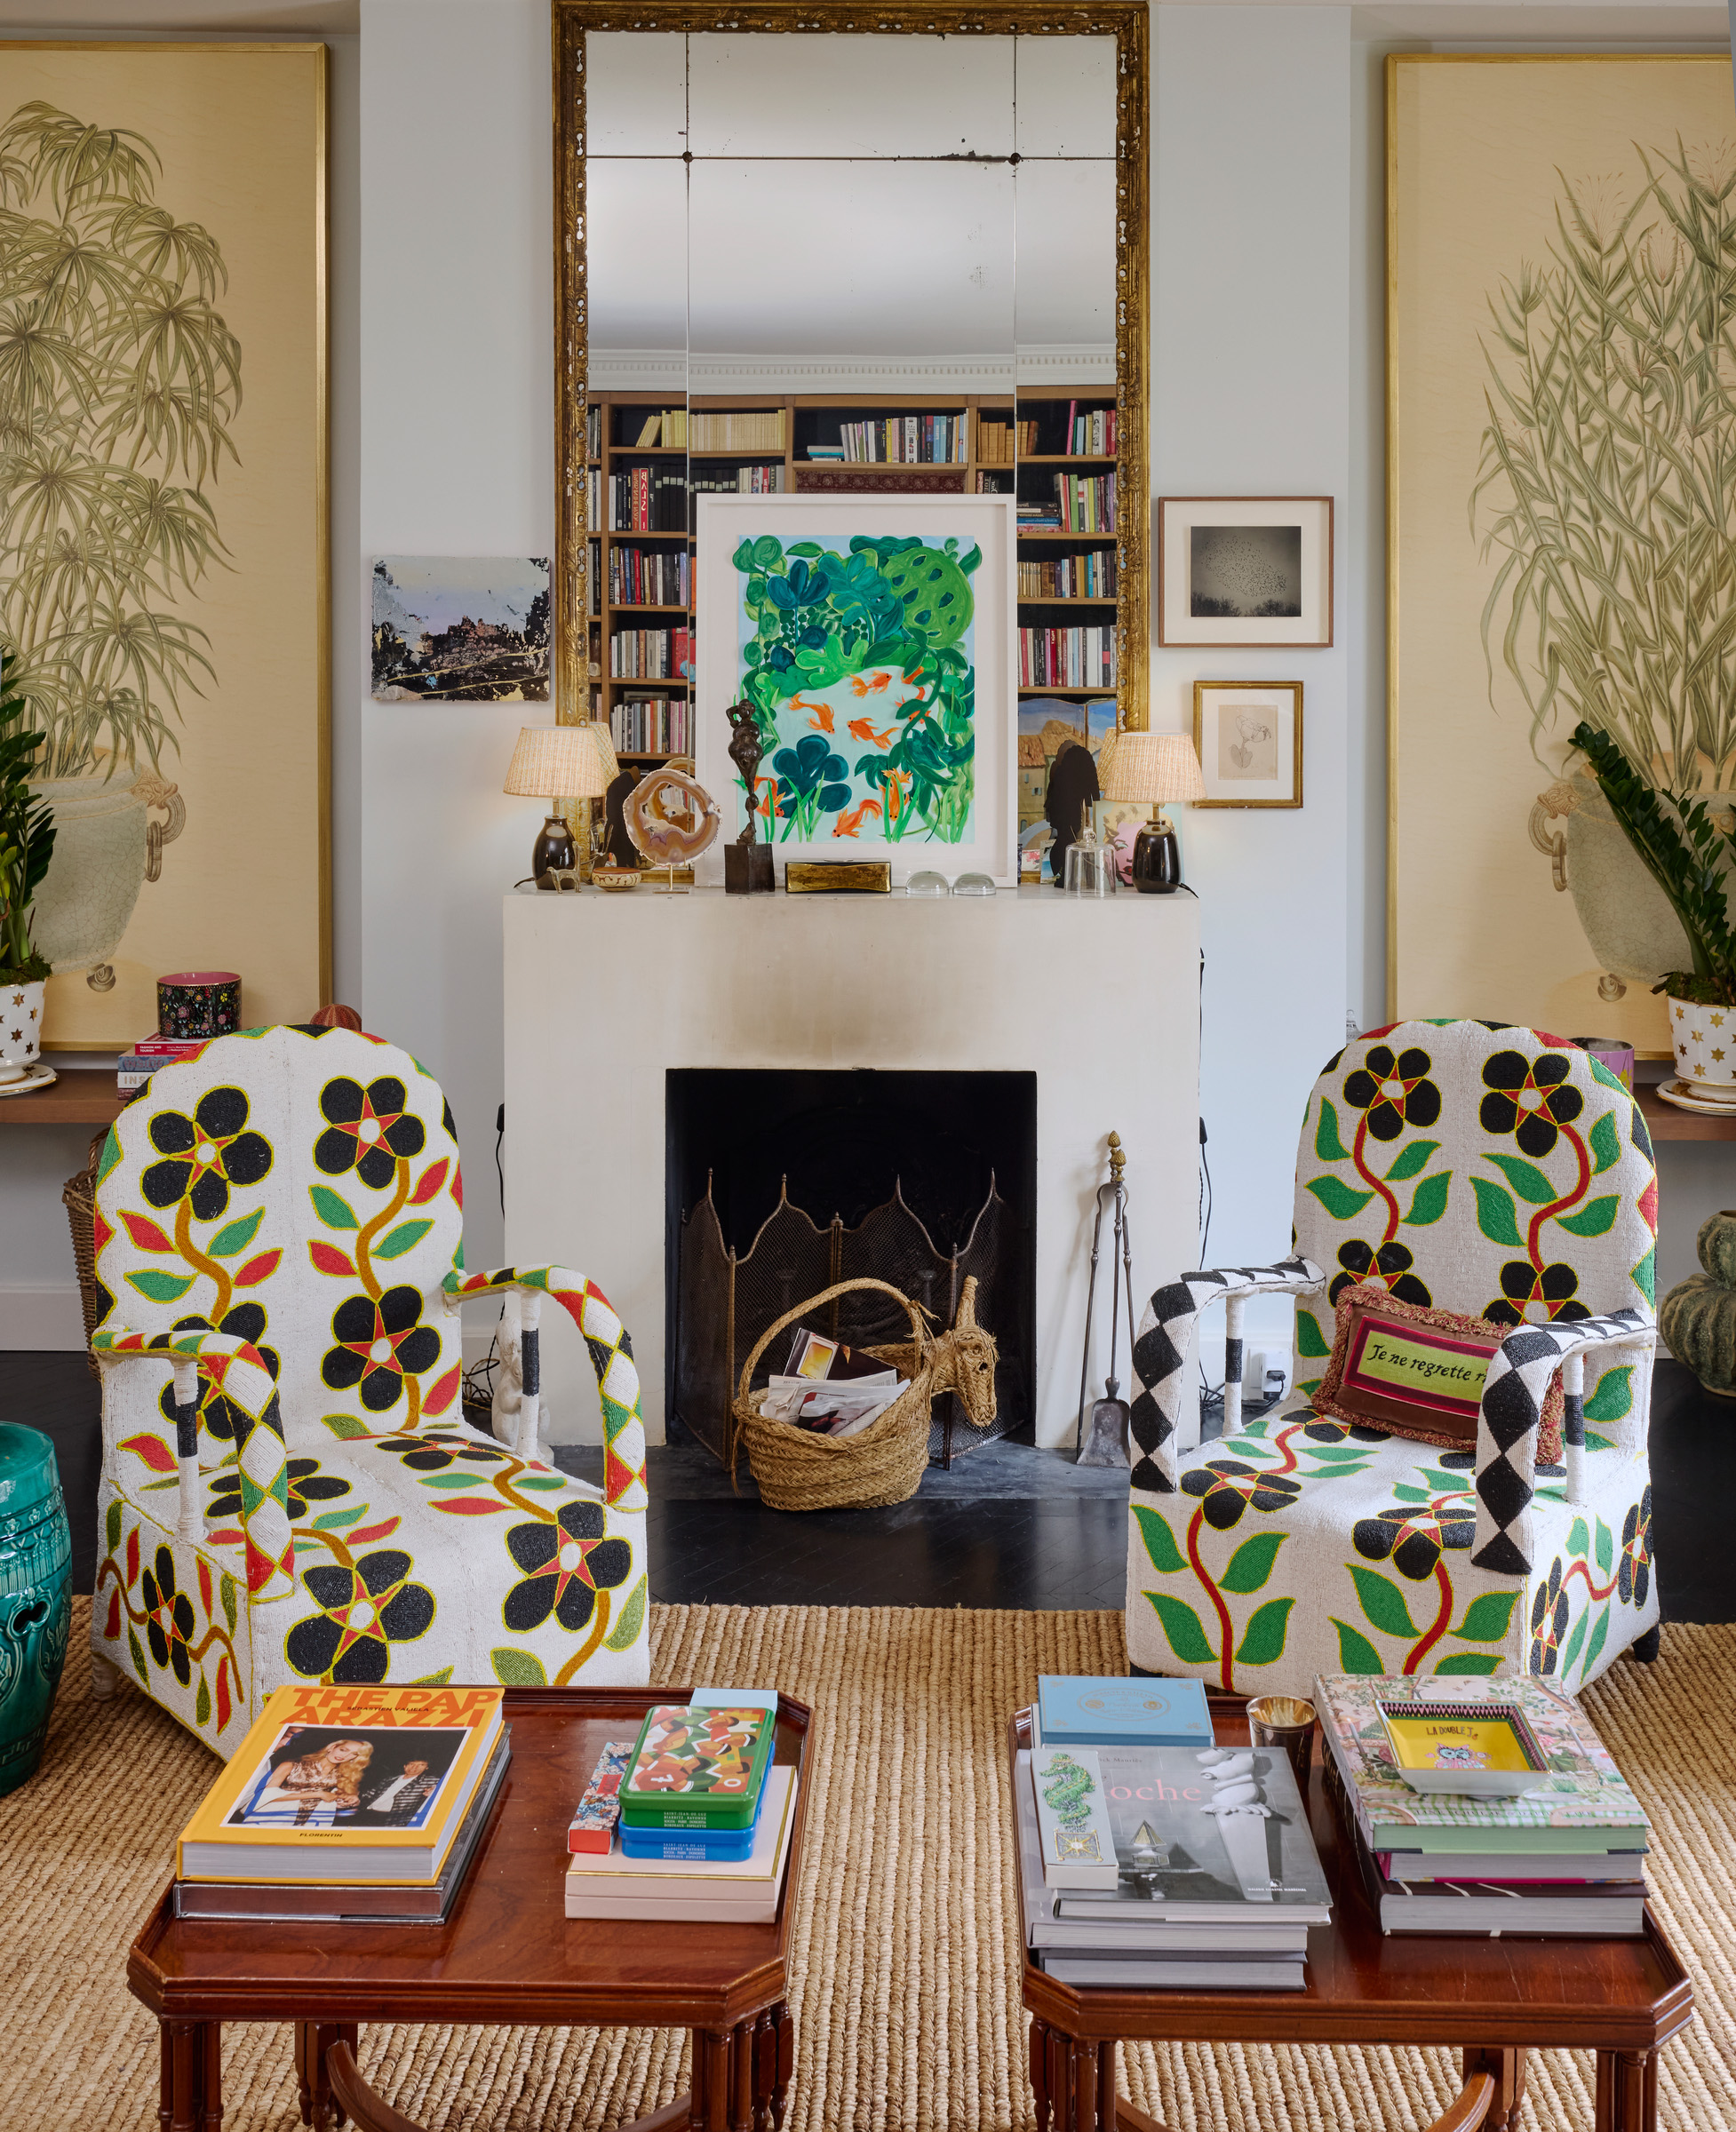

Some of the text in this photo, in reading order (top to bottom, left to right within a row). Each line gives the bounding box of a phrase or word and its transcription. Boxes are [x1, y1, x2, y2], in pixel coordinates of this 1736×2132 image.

[124, 1059, 163, 1068] INSIDE
[124, 1075, 146, 1085] INS
[1366, 1344, 1386, 1361] Je
[1390, 1353, 1407, 1366] ne
[1412, 1358, 1471, 1381] regrette
[292, 1688, 500, 1711] THE PAP
[278, 1706, 485, 1729] ARAZZI
[1426, 1726, 1474, 1737] LA DOUBLE J
[1104, 1778, 1202, 1801] oche
